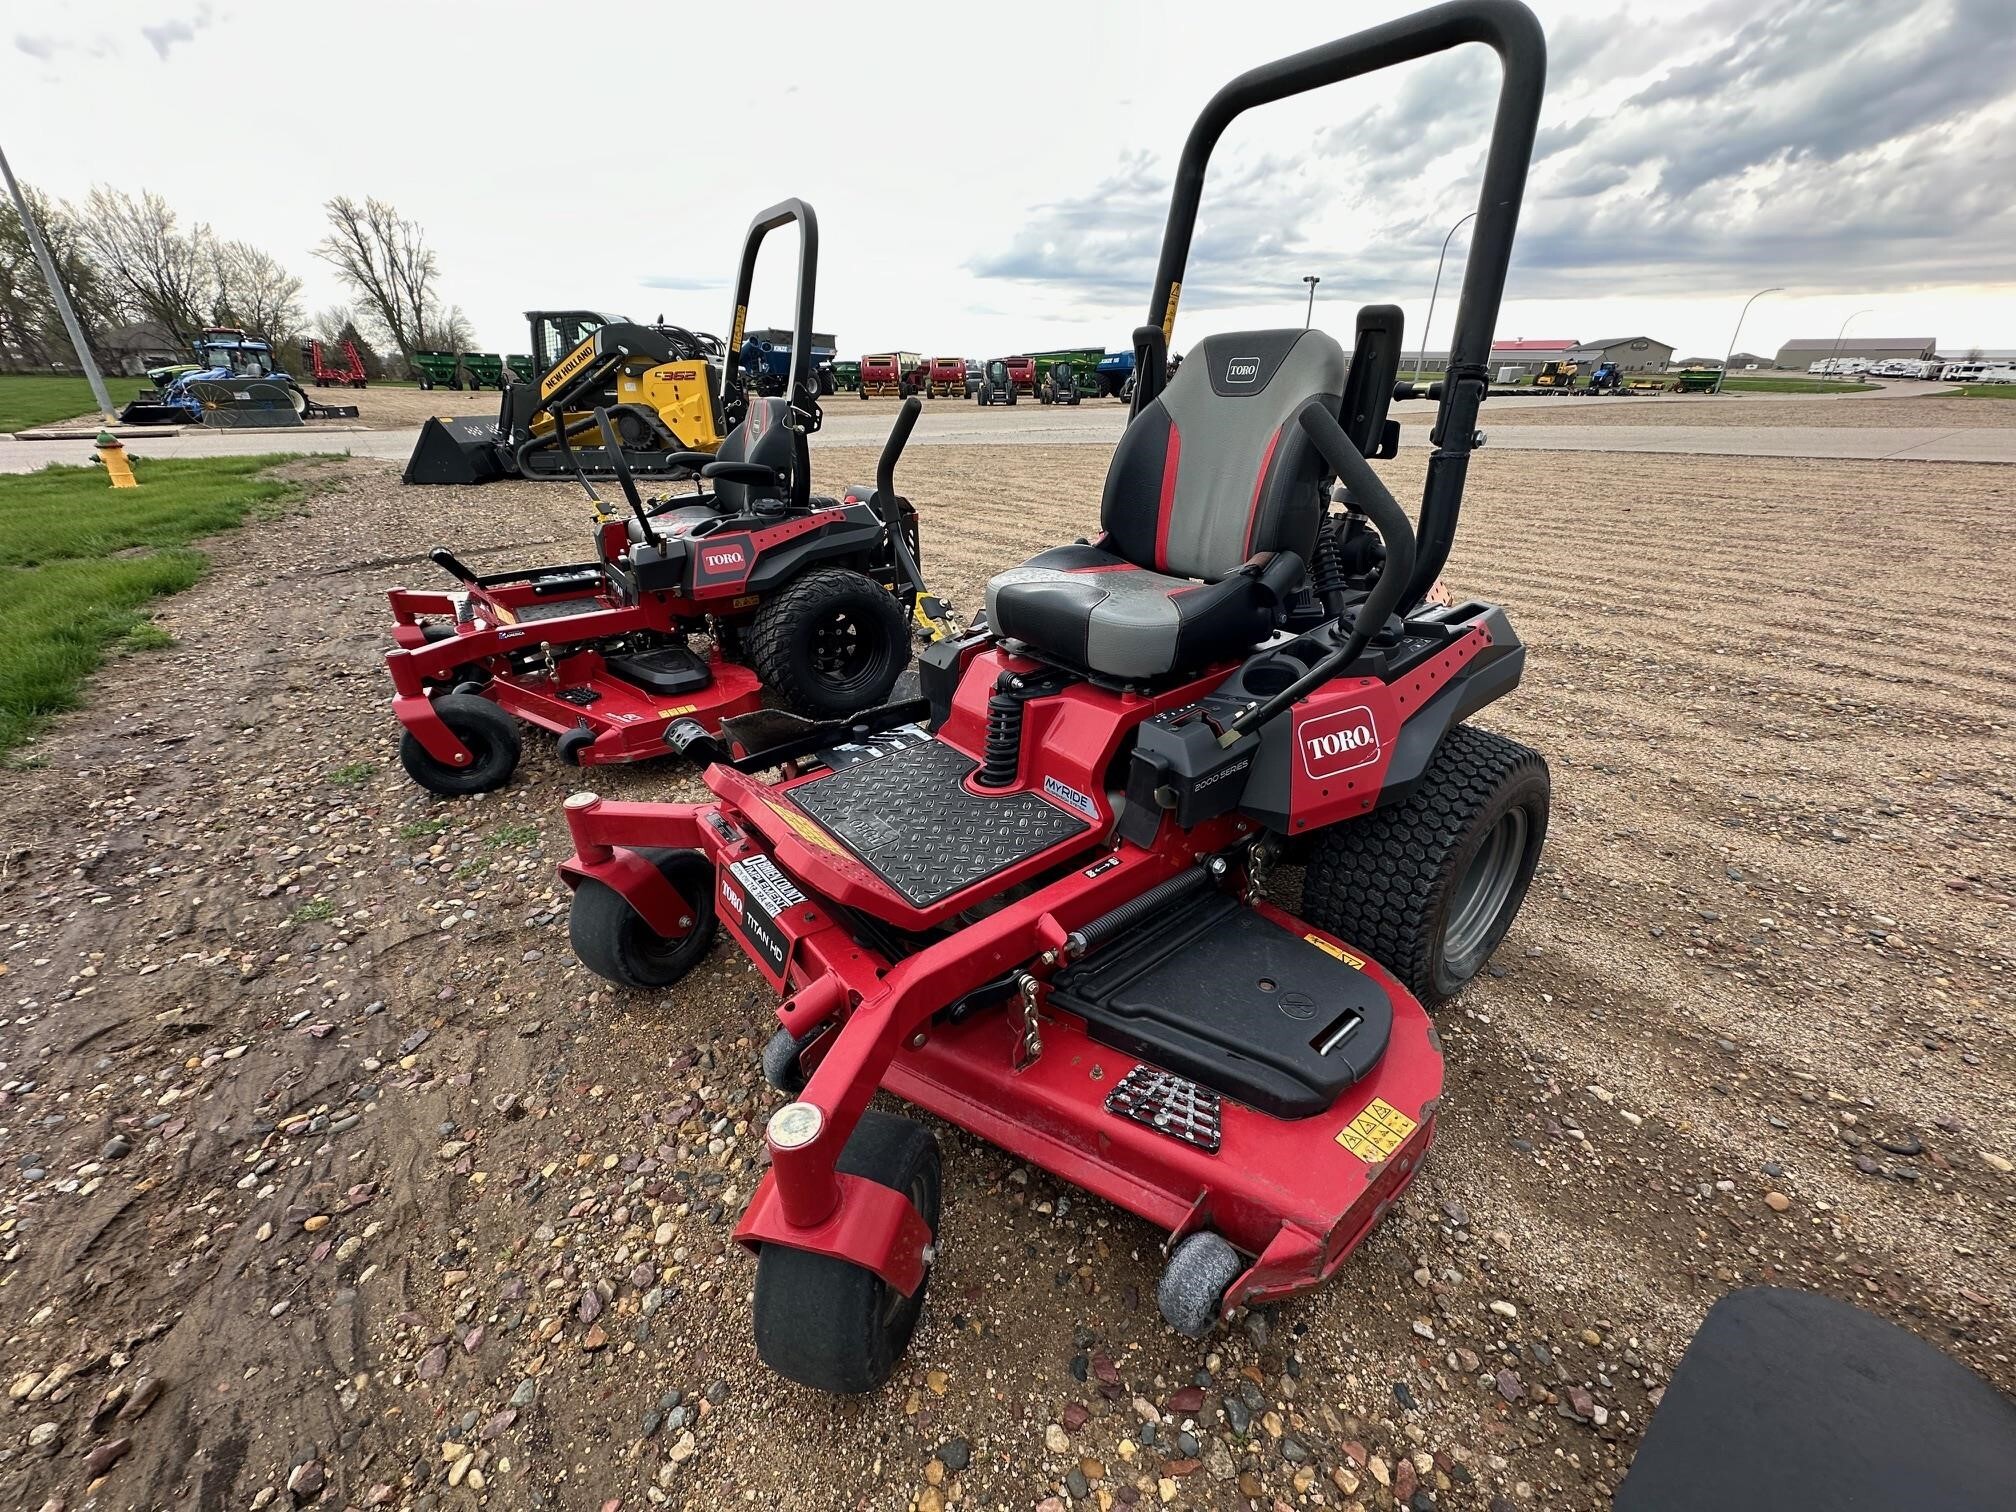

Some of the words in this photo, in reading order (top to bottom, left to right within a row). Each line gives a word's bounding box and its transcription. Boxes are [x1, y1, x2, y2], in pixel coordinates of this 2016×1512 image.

[545, 370, 563, 390] NEW
[561, 346, 593, 379] HOLLAND
[1230, 365, 1256, 376] TORO
[705, 552, 743, 567] TORO
[1307, 725, 1373, 760] TORO
[1194, 774, 1220, 792] 2000
[1219, 760, 1249, 780] SERIES
[721, 880, 743, 915] TORO
[745, 865, 790, 909] IMPLEMENT
[746, 912, 770, 947] TITAN
[769, 940, 783, 962] HD
